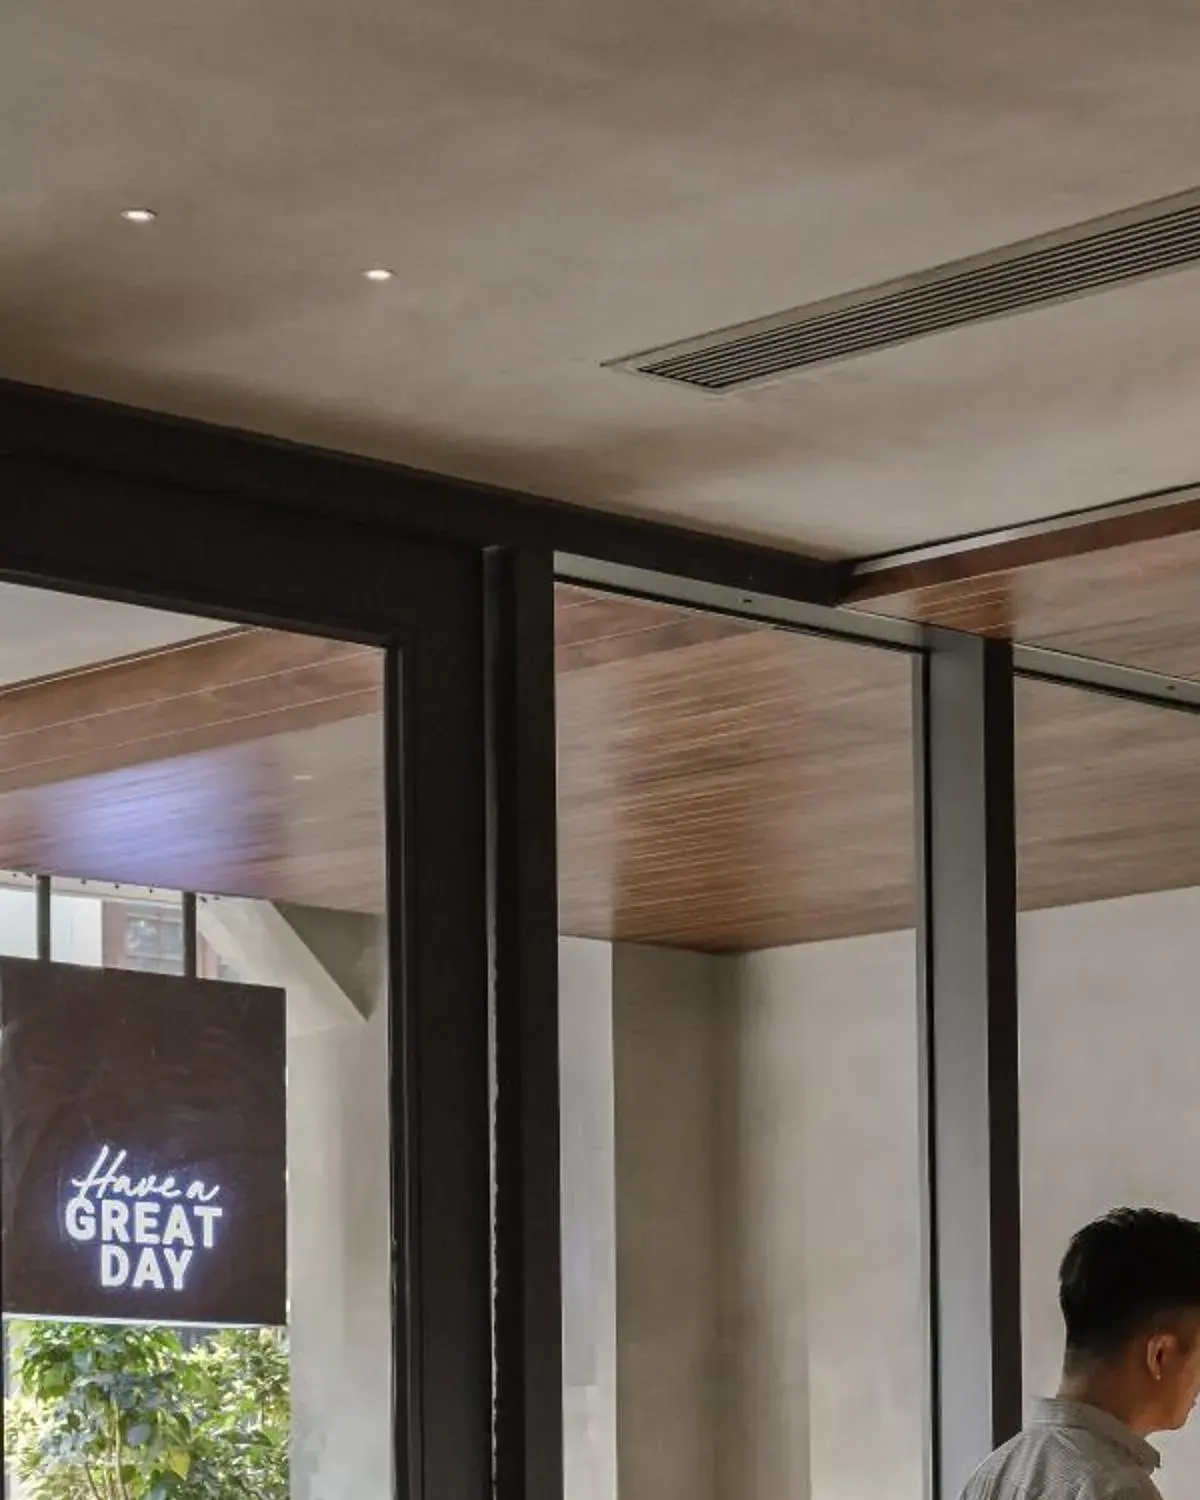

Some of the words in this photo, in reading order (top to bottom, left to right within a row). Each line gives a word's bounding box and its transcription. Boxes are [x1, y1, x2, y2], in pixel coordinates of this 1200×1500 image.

[71, 1144, 183, 1199] Have
[185, 1180, 220, 1202] a
[65, 1197, 223, 1249] GREAT
[100, 1243, 194, 1291] DAY
